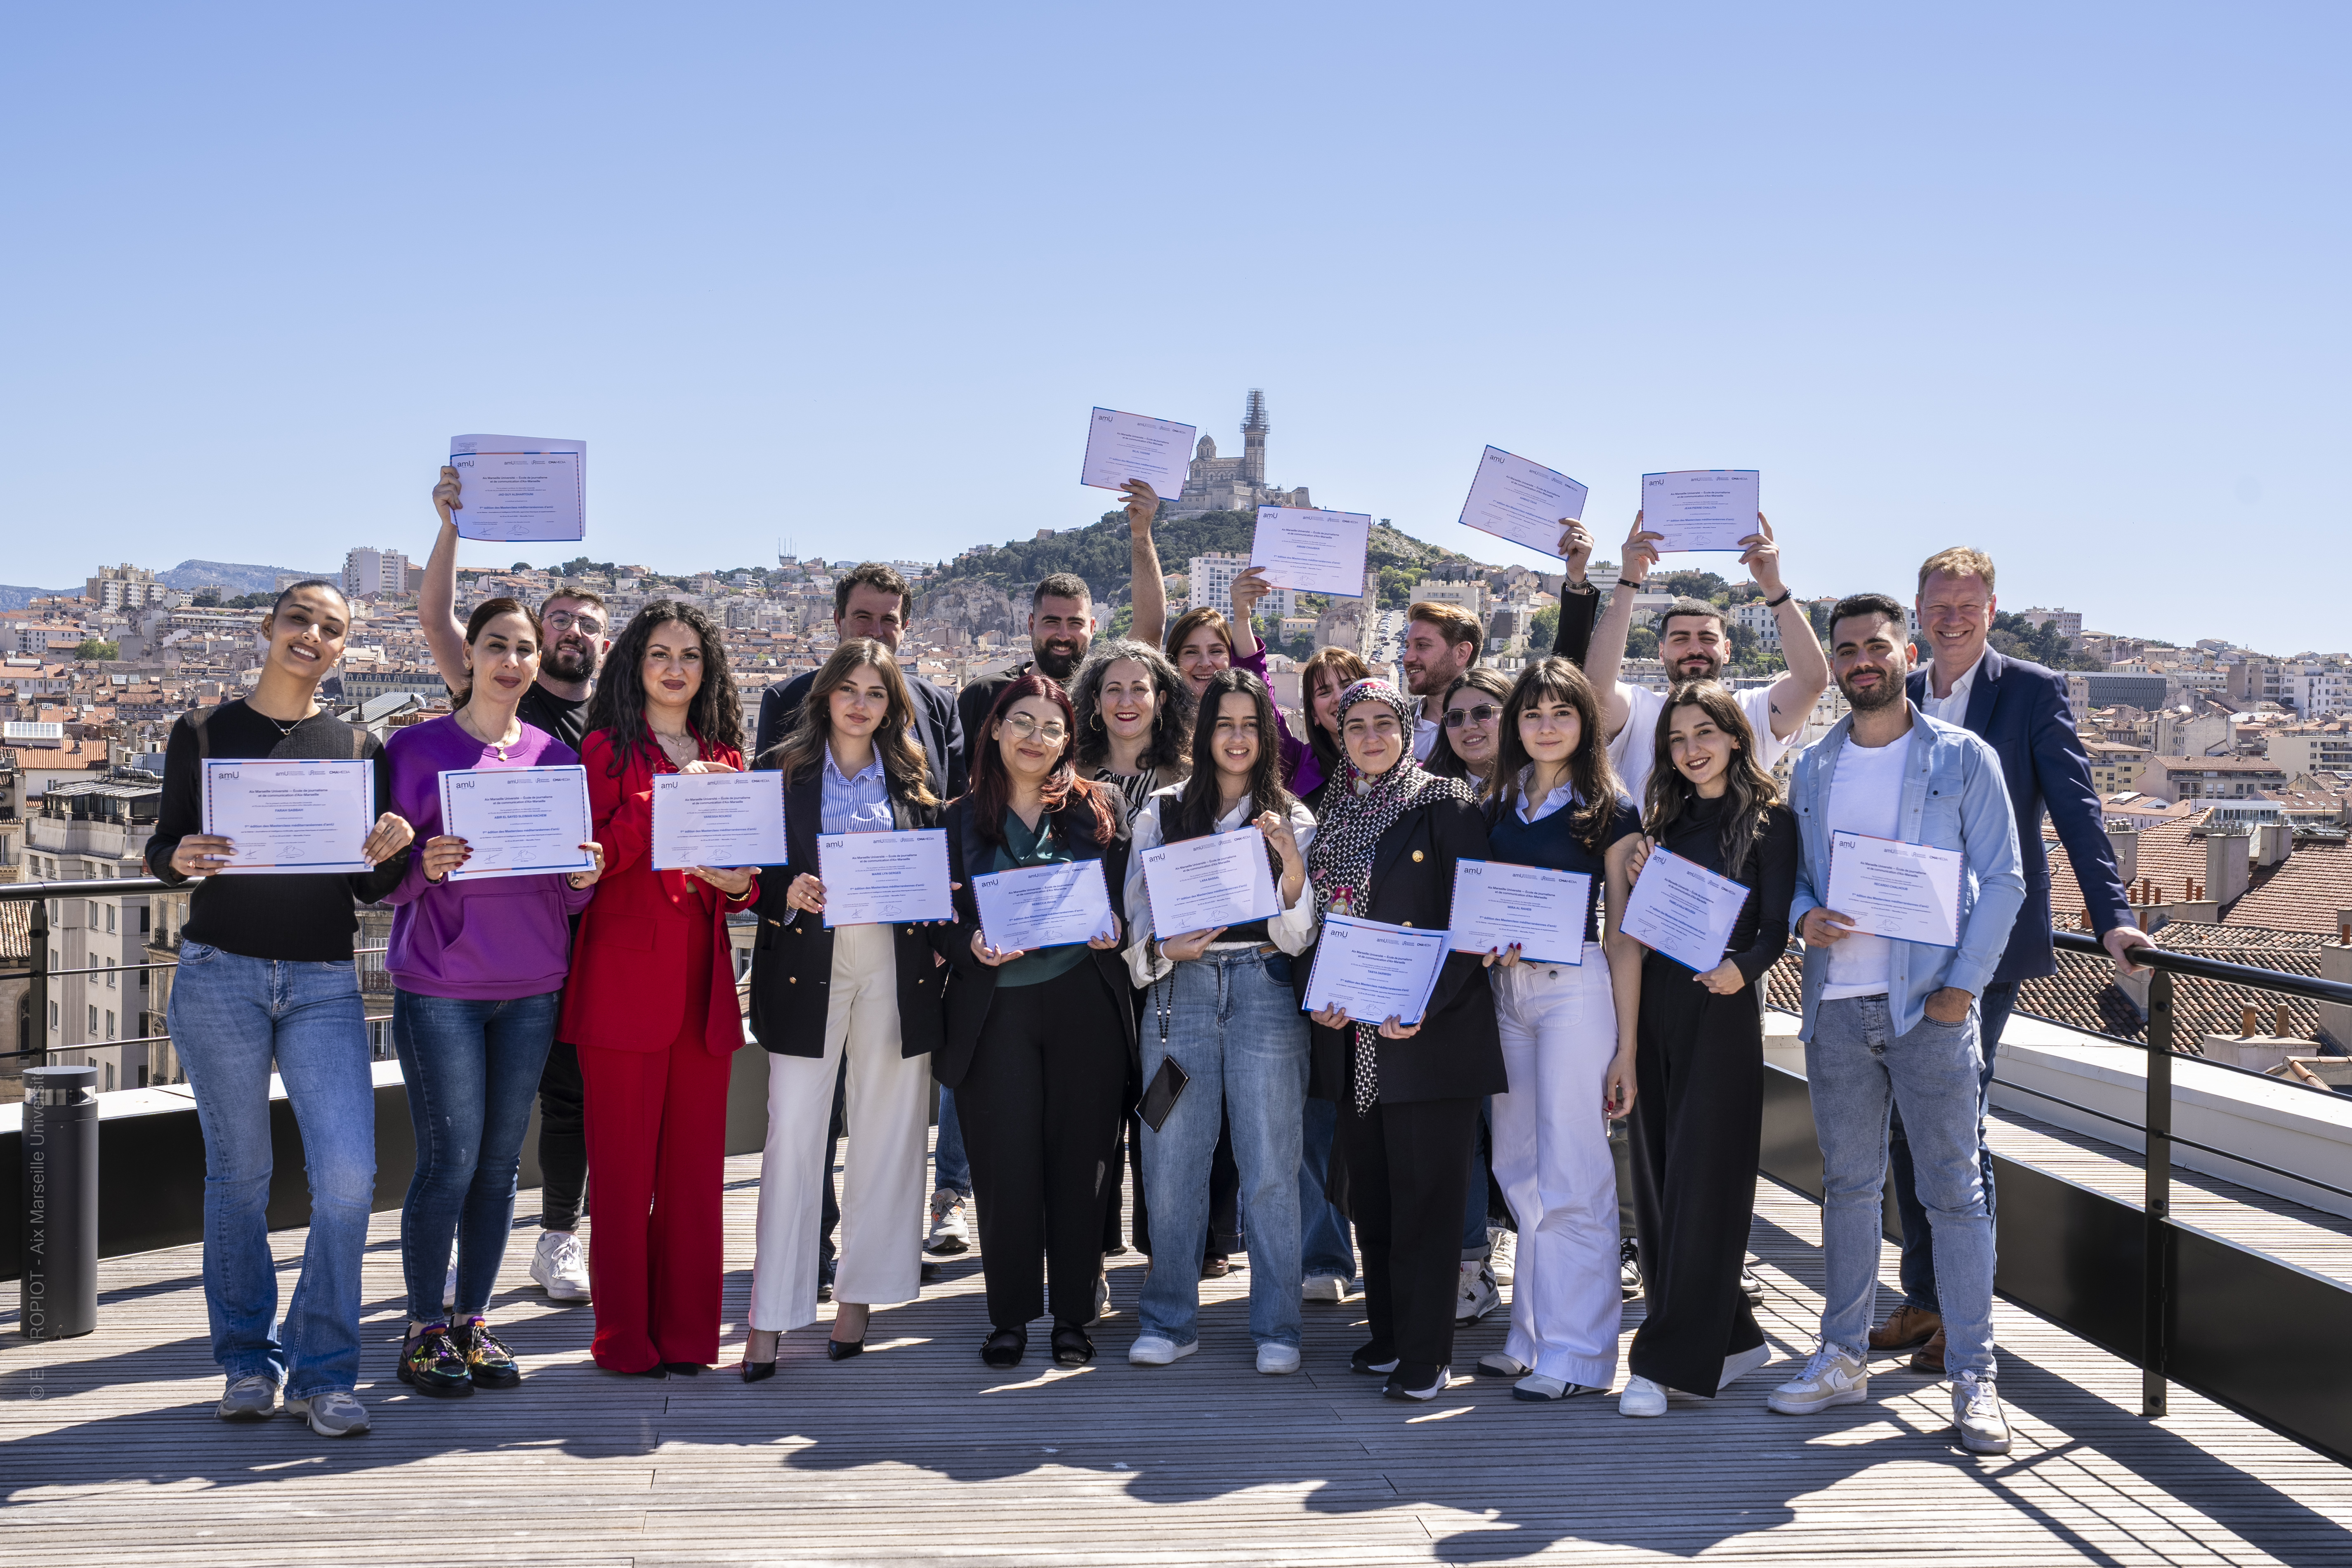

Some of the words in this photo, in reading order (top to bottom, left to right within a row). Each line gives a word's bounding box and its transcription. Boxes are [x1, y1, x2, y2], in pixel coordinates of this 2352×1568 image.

[1489, 455, 1505, 463] amU
[1149, 853, 1165, 862] amU
[981, 879, 998, 887] amU
